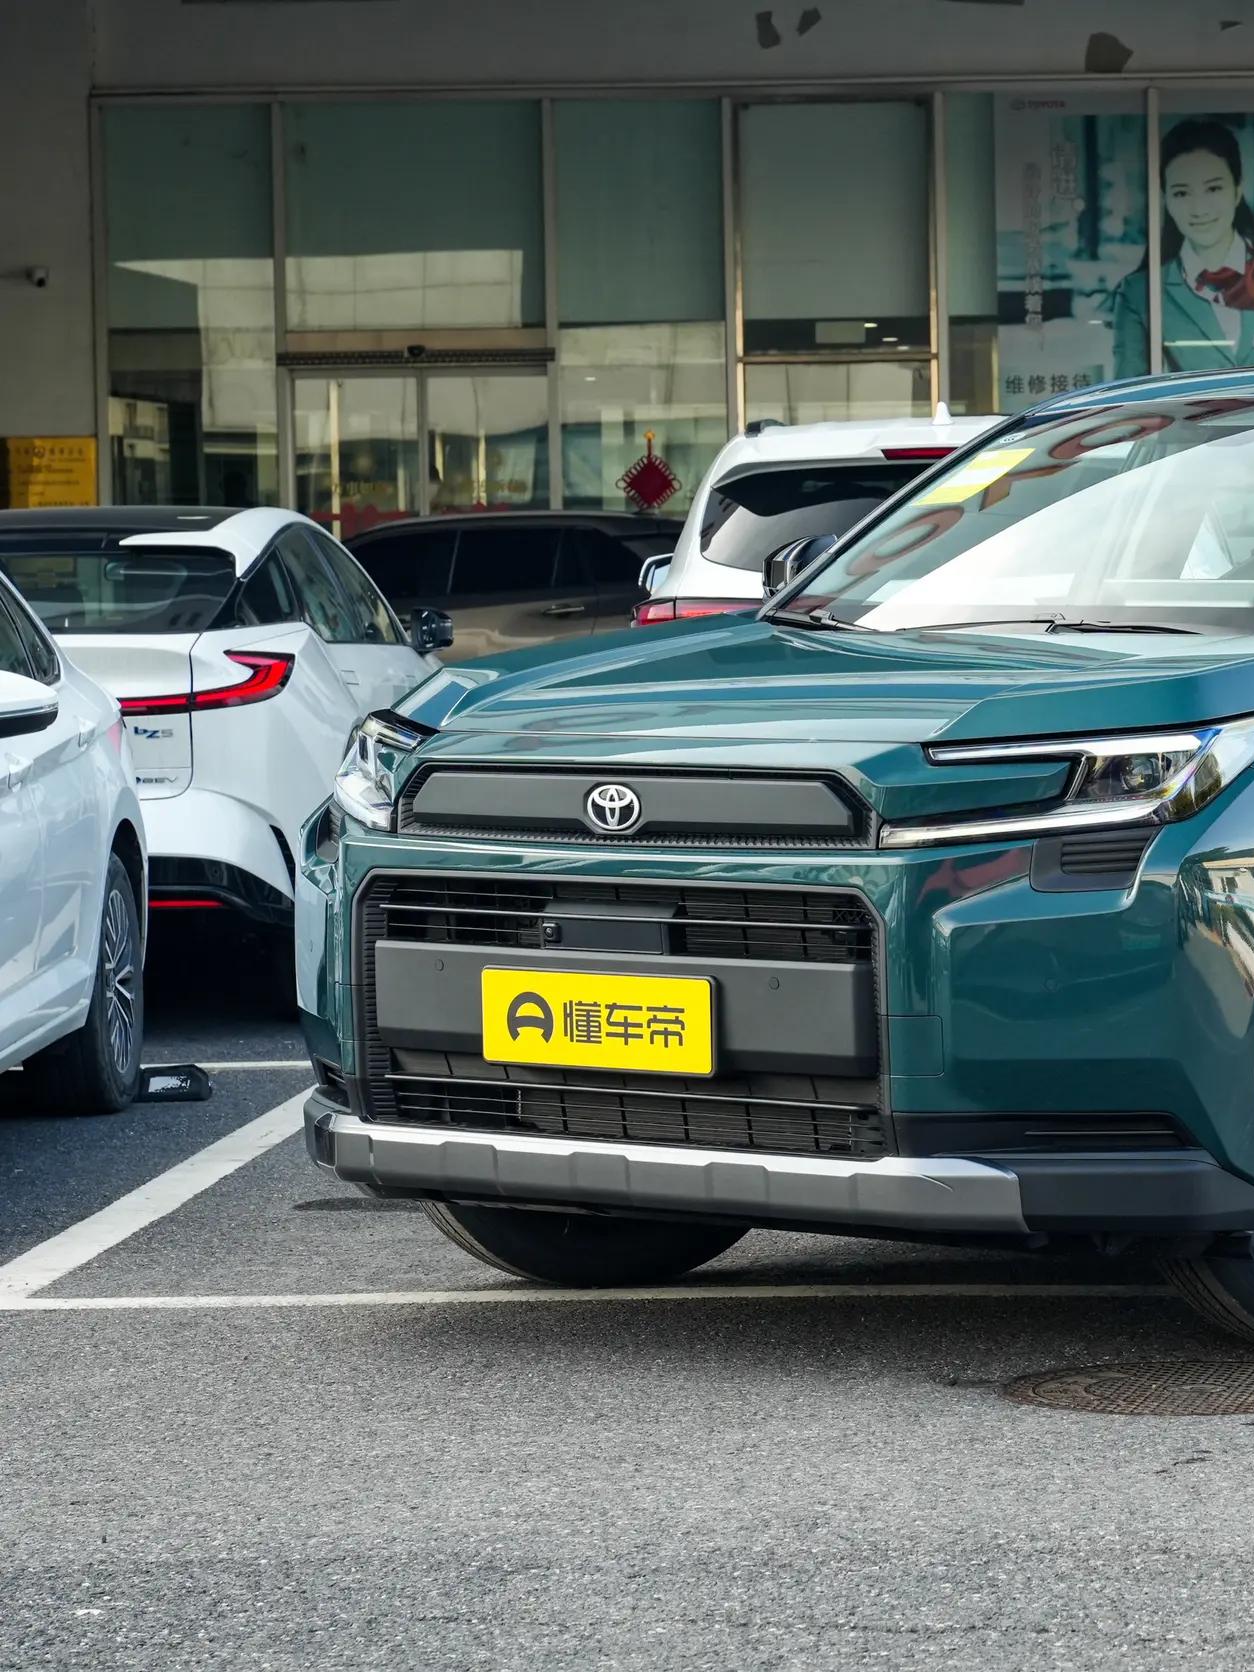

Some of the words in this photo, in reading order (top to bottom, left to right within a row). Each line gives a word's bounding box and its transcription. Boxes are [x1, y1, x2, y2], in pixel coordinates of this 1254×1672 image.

[1004, 374, 1093, 396] 维修接待
[563, 1000, 686, 1049] 懂车帝
